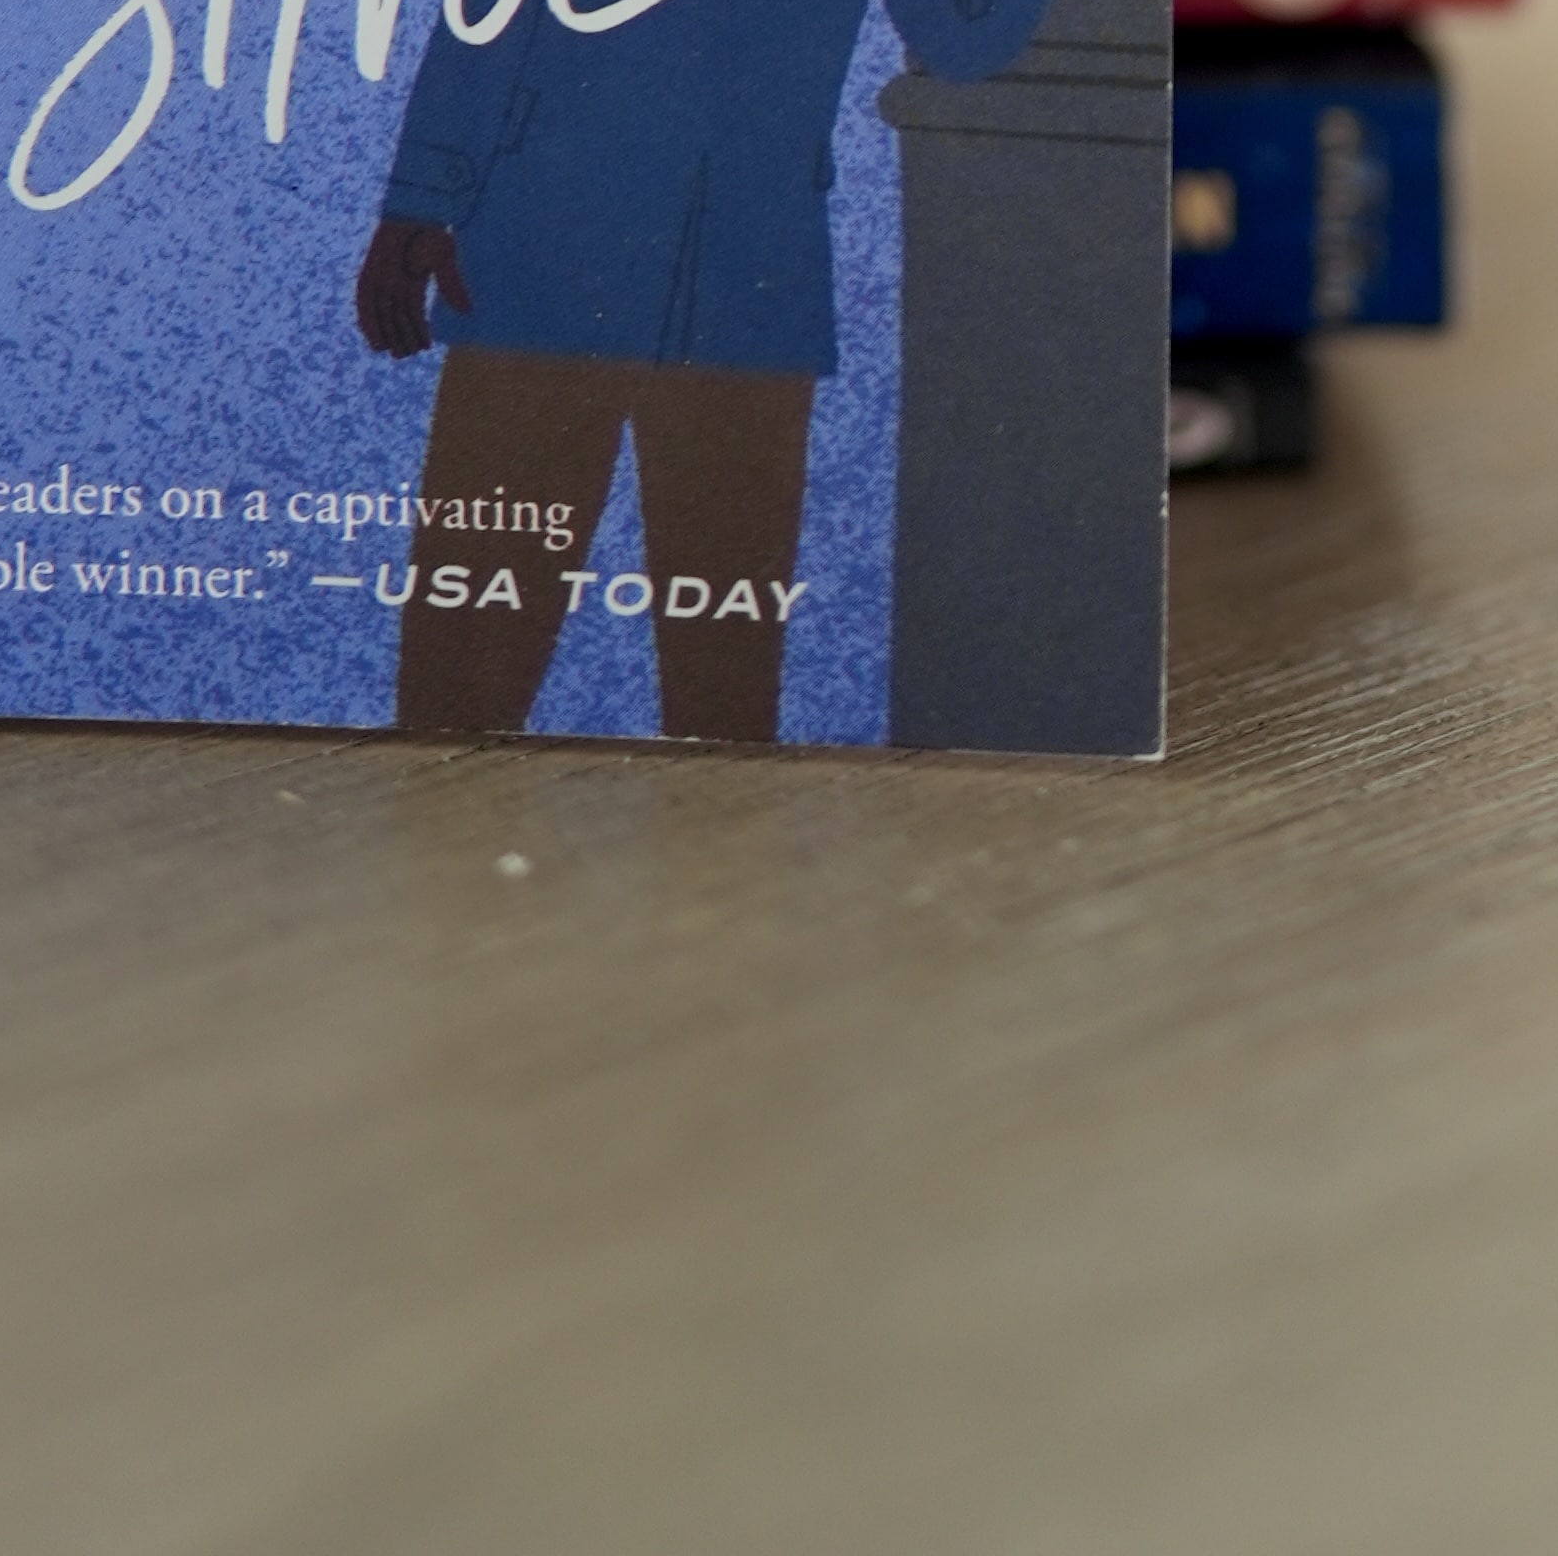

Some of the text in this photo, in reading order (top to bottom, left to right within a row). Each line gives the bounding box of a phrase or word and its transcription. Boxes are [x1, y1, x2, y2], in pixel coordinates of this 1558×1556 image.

[161, 486, 224, 520] on
[243, 488, 269, 522] a
[287, 481, 575, 551] captivating
[560, 571, 809, 622] TODAY
